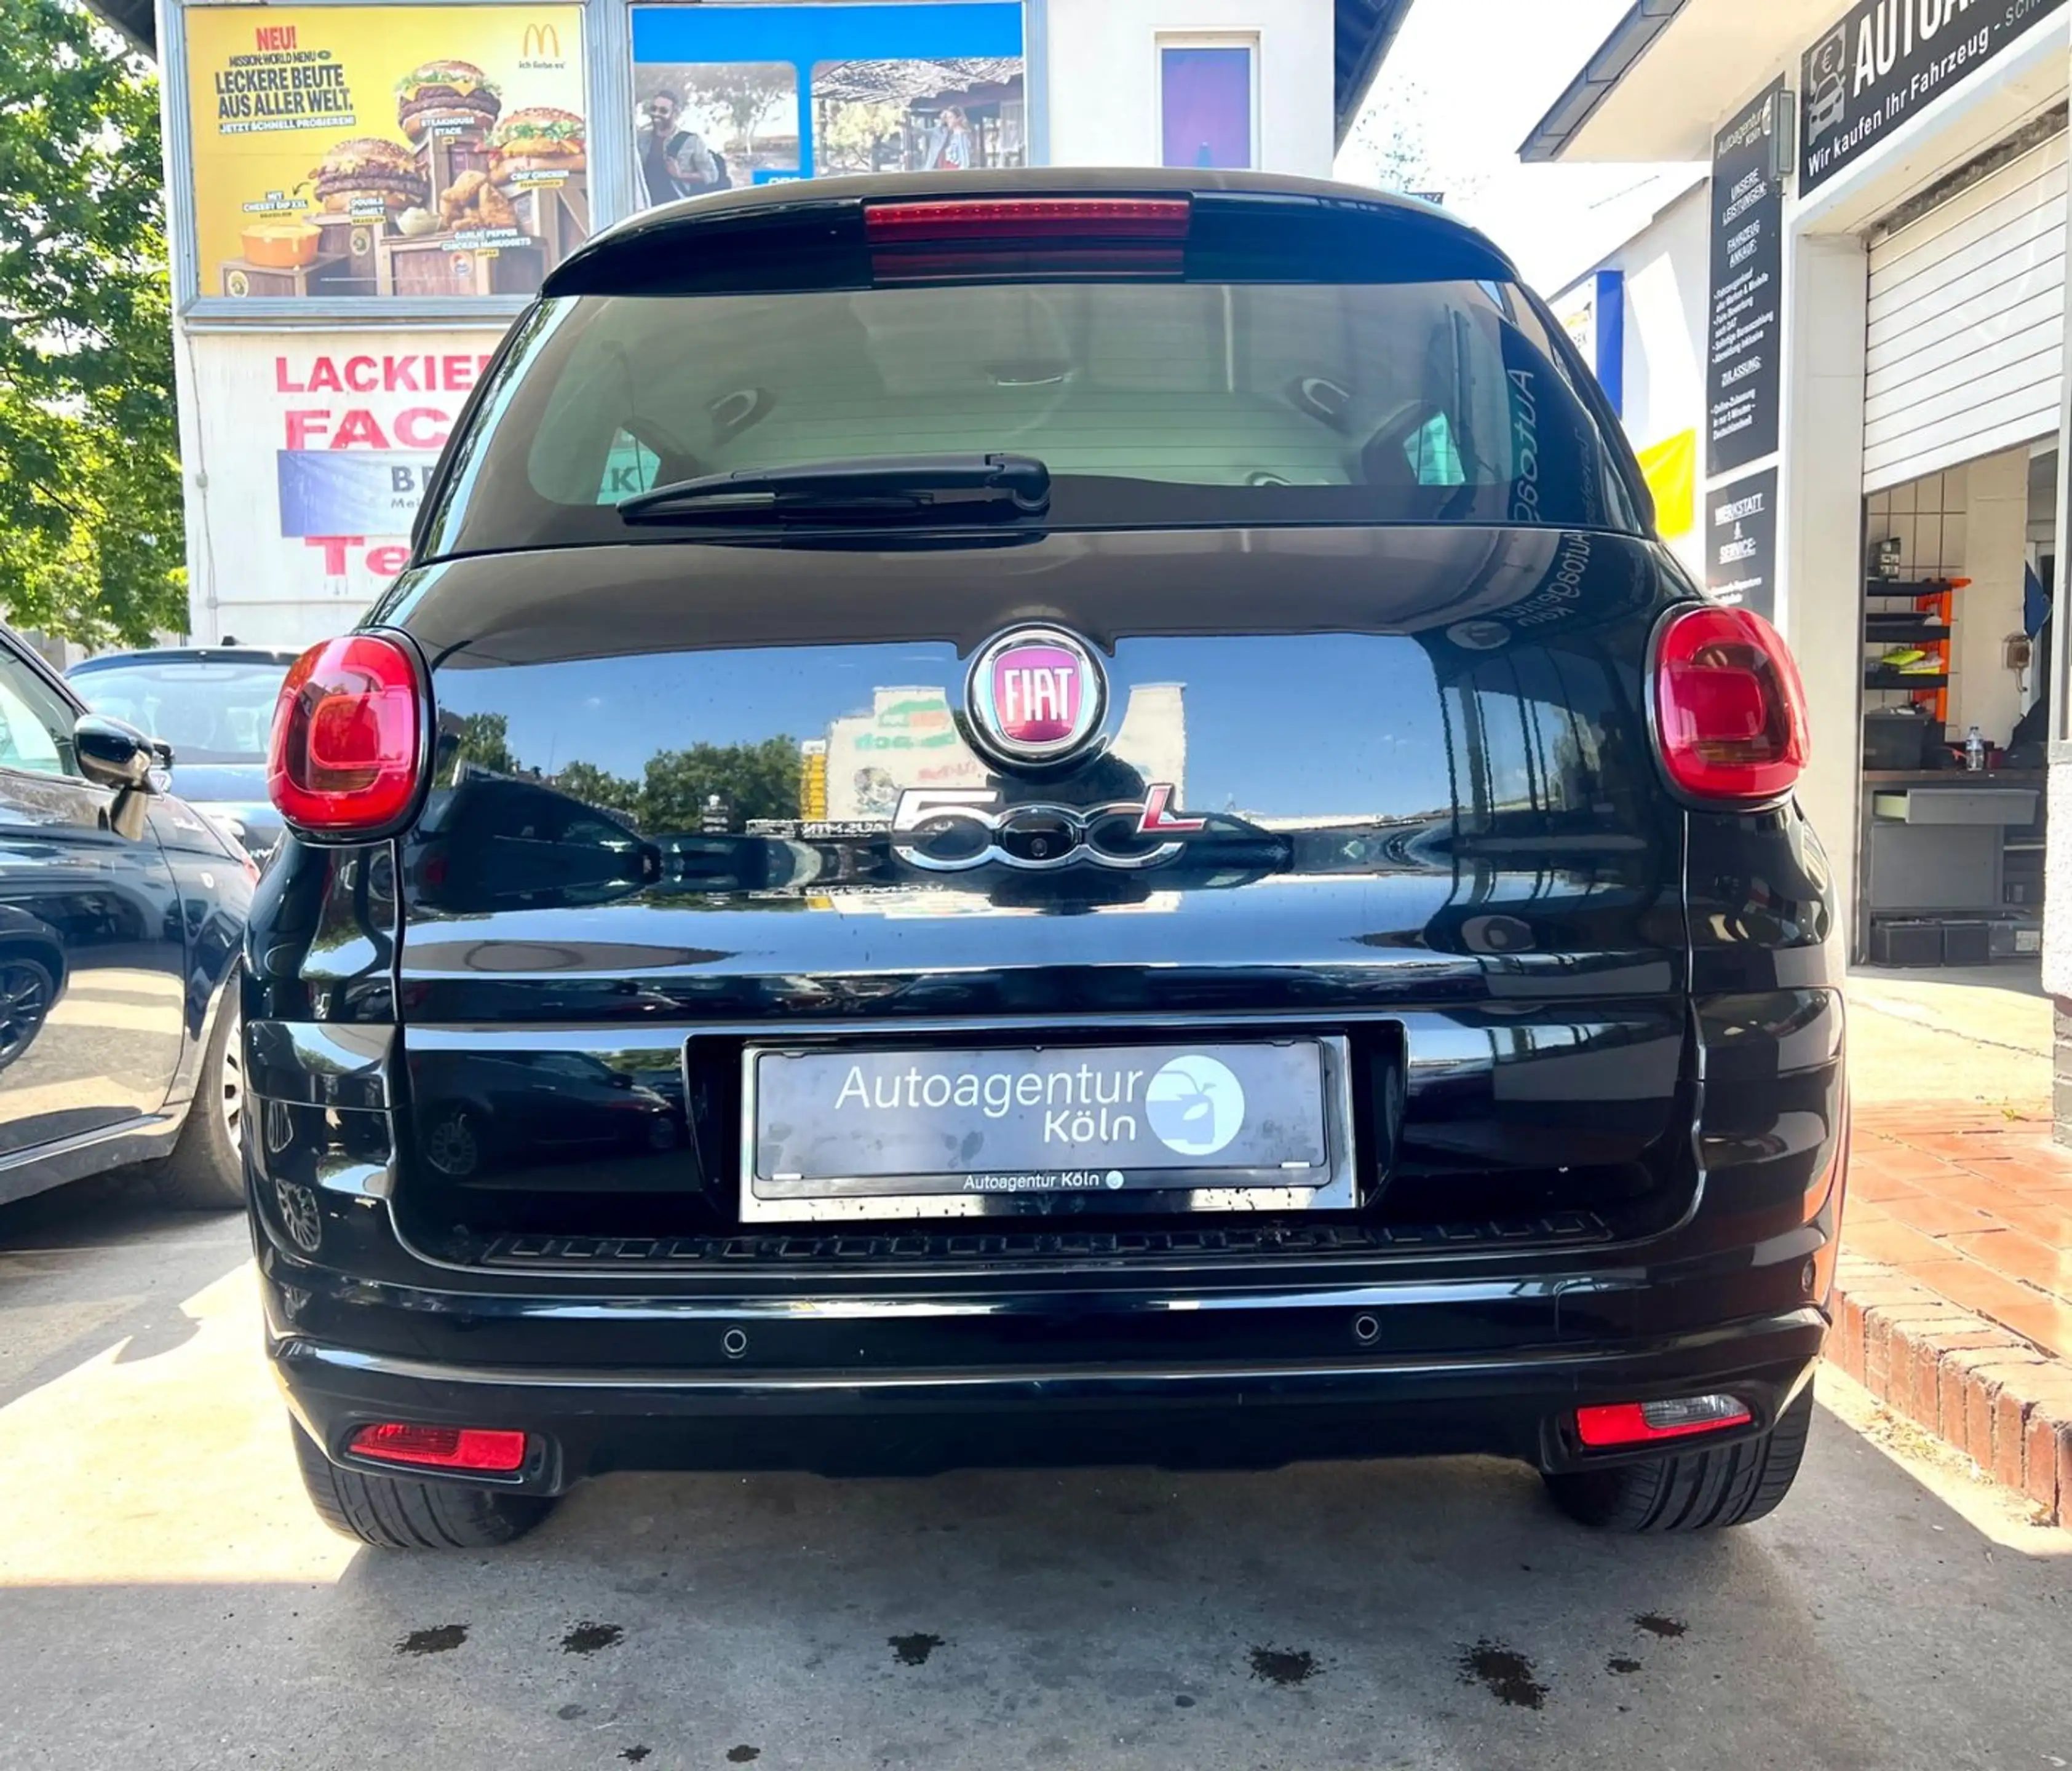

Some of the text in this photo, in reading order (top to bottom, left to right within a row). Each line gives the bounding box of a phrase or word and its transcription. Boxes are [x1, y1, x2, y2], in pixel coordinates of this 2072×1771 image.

[254, 25, 297, 51] NEU!
[215, 64, 344, 95] LECKERE BEUTE
[218, 89, 354, 119] AUS ALLER WELT.
[1808, 147, 1831, 178] Wir
[1833, 109, 1882, 160] kaufen
[1885, 88, 1907, 120] Ihr
[1910, 26, 1989, 101] Fahrzeug
[251, 121, 296, 132] SCHNELL
[1715, 493, 1763, 523] WERKSTATT
[1004, 667, 1074, 723] FIAT
[835, 1065, 1144, 1117] Autoagentur
[1042, 1107, 1137, 1143] Köln
[963, 1171, 1100, 1192] Autoagentur Köln
